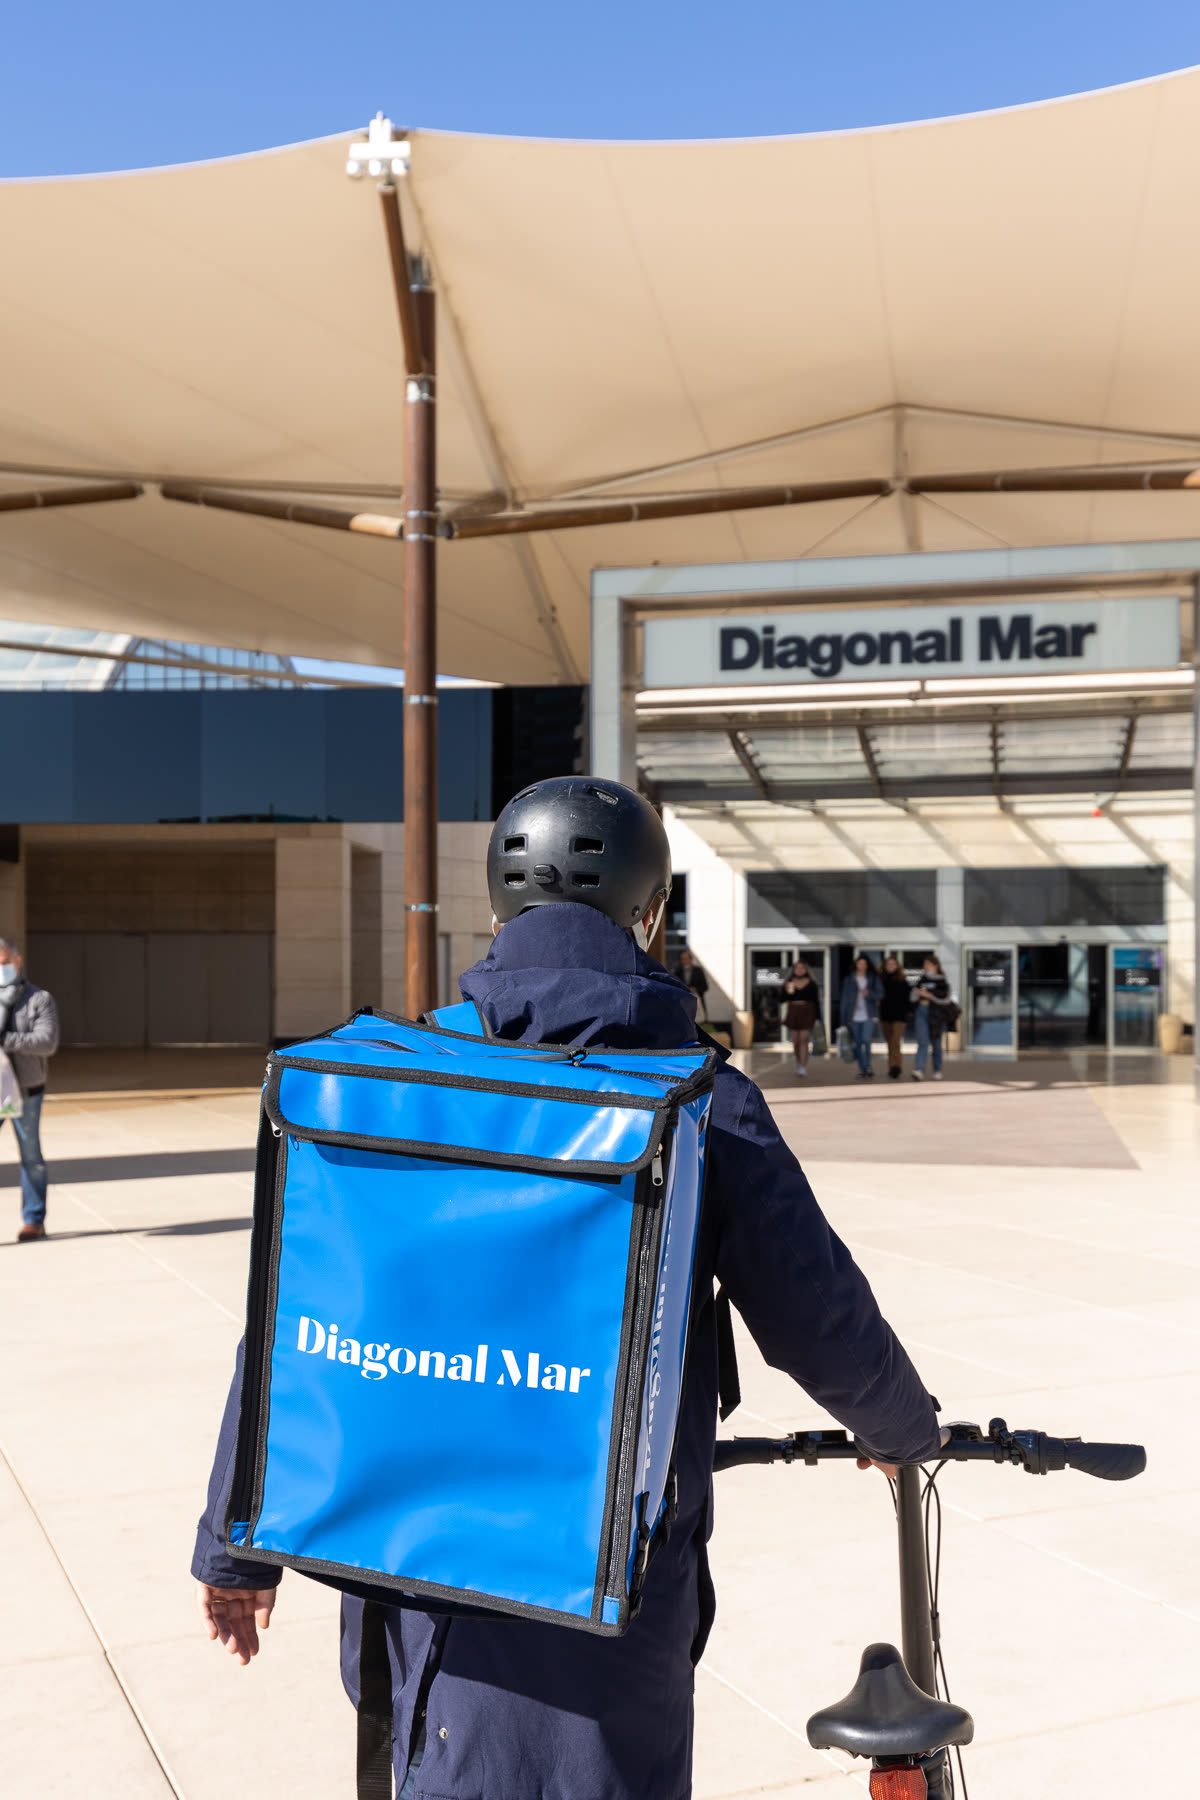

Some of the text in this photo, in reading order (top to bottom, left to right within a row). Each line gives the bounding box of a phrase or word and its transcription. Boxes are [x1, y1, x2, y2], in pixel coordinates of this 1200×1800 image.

[720, 614, 1097, 679] Diagonal Mar
[297, 1315, 591, 1394] Diagonal Mar
